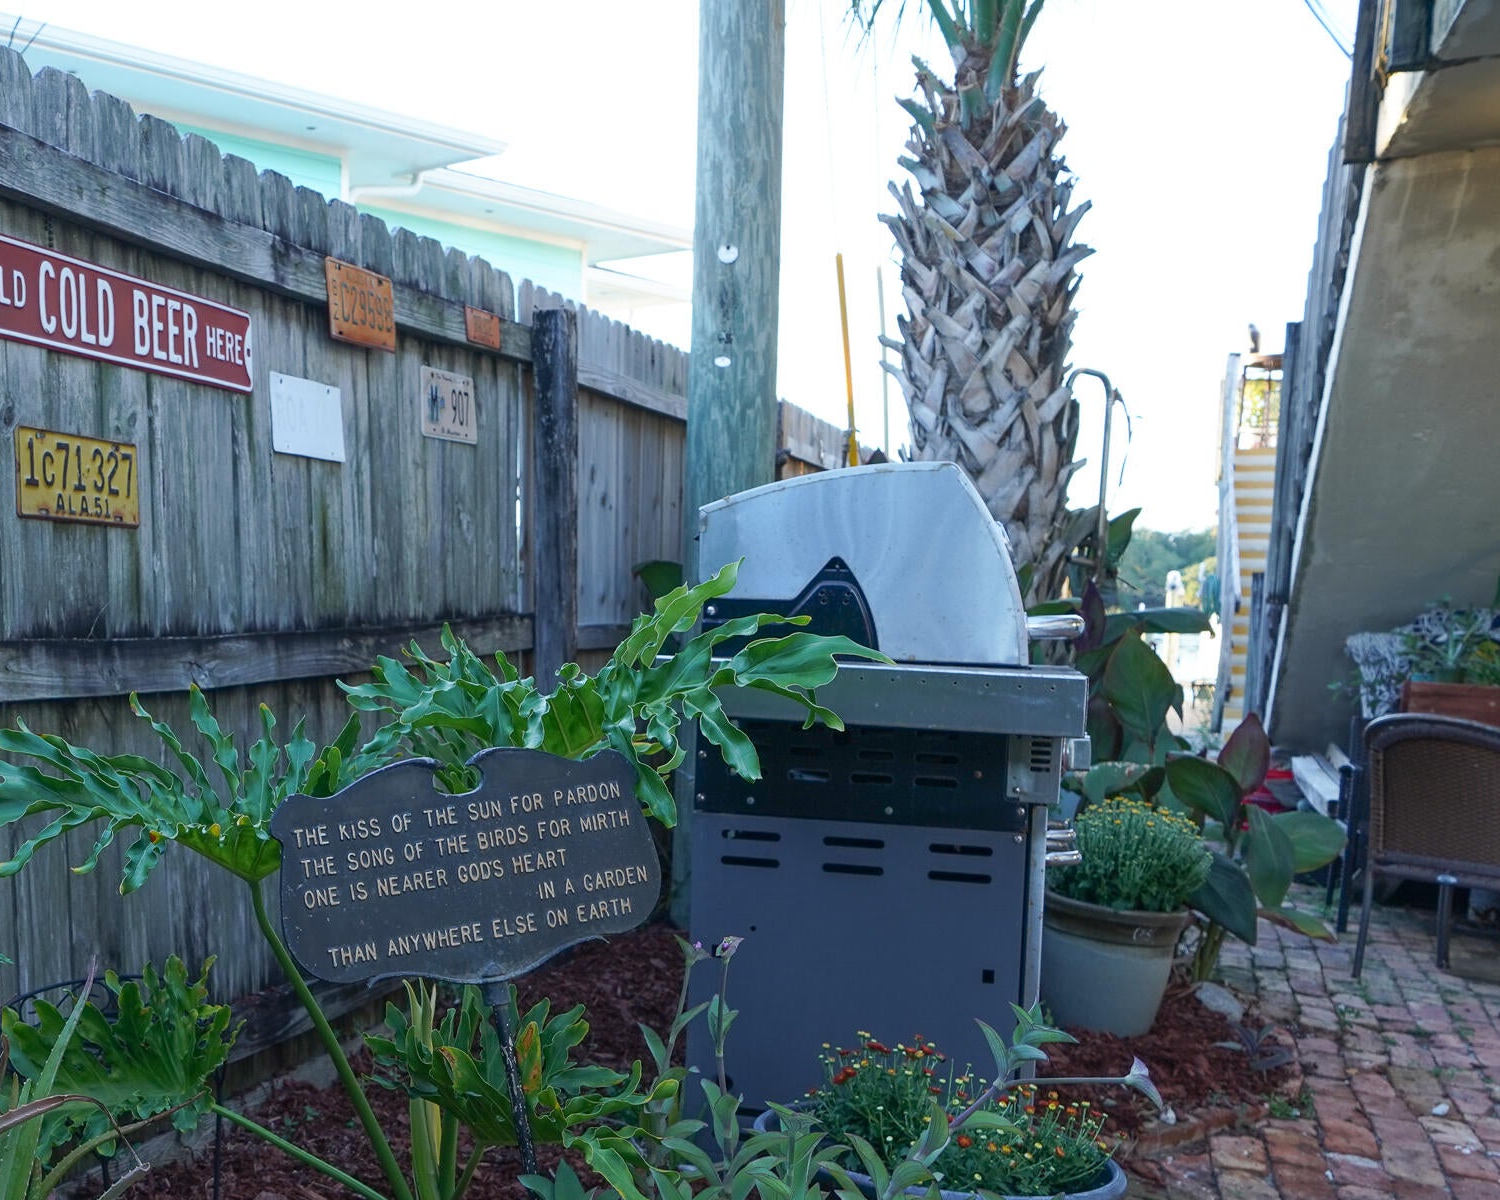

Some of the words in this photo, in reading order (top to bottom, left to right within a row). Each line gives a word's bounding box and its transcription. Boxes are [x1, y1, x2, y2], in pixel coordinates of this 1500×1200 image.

[39, 260, 115, 348] COLD
[132, 288, 199, 369] BEER
[206, 324, 244, 366] HERE
[451, 388, 469, 427] 907
[293, 825, 330, 848] THE
[338, 818, 381, 841] KISS
[391, 812, 412, 834] OF
[423, 806, 458, 827] THE
[467, 800, 502, 822] SUN
[510, 793, 544, 815] FOR
[554, 782, 621, 807] PARDON
[300, 856, 337, 878] THE
[347, 847, 395, 871] SONG
[404, 841, 423, 862] OF
[435, 834, 469, 856] THE
[477, 825, 529, 851] BIRDS
[537, 818, 572, 840] FOR
[579, 809, 631, 834] MIRTH
[304, 886, 340, 909] ONE
[349, 882, 368, 901] IS
[376, 868, 448, 897] NEARER
[457, 859, 504, 884] GOD'S
[512, 848, 566, 875] HEART
[538, 880, 556, 900] IN
[565, 878, 575, 895] A
[583, 865, 648, 892] GARDEN
[328, 943, 377, 968] THAN
[387, 923, 484, 958] ANYWHERE
[493, 913, 538, 939] ELSE
[546, 908, 569, 929] ON
[576, 897, 632, 923] EARTH
